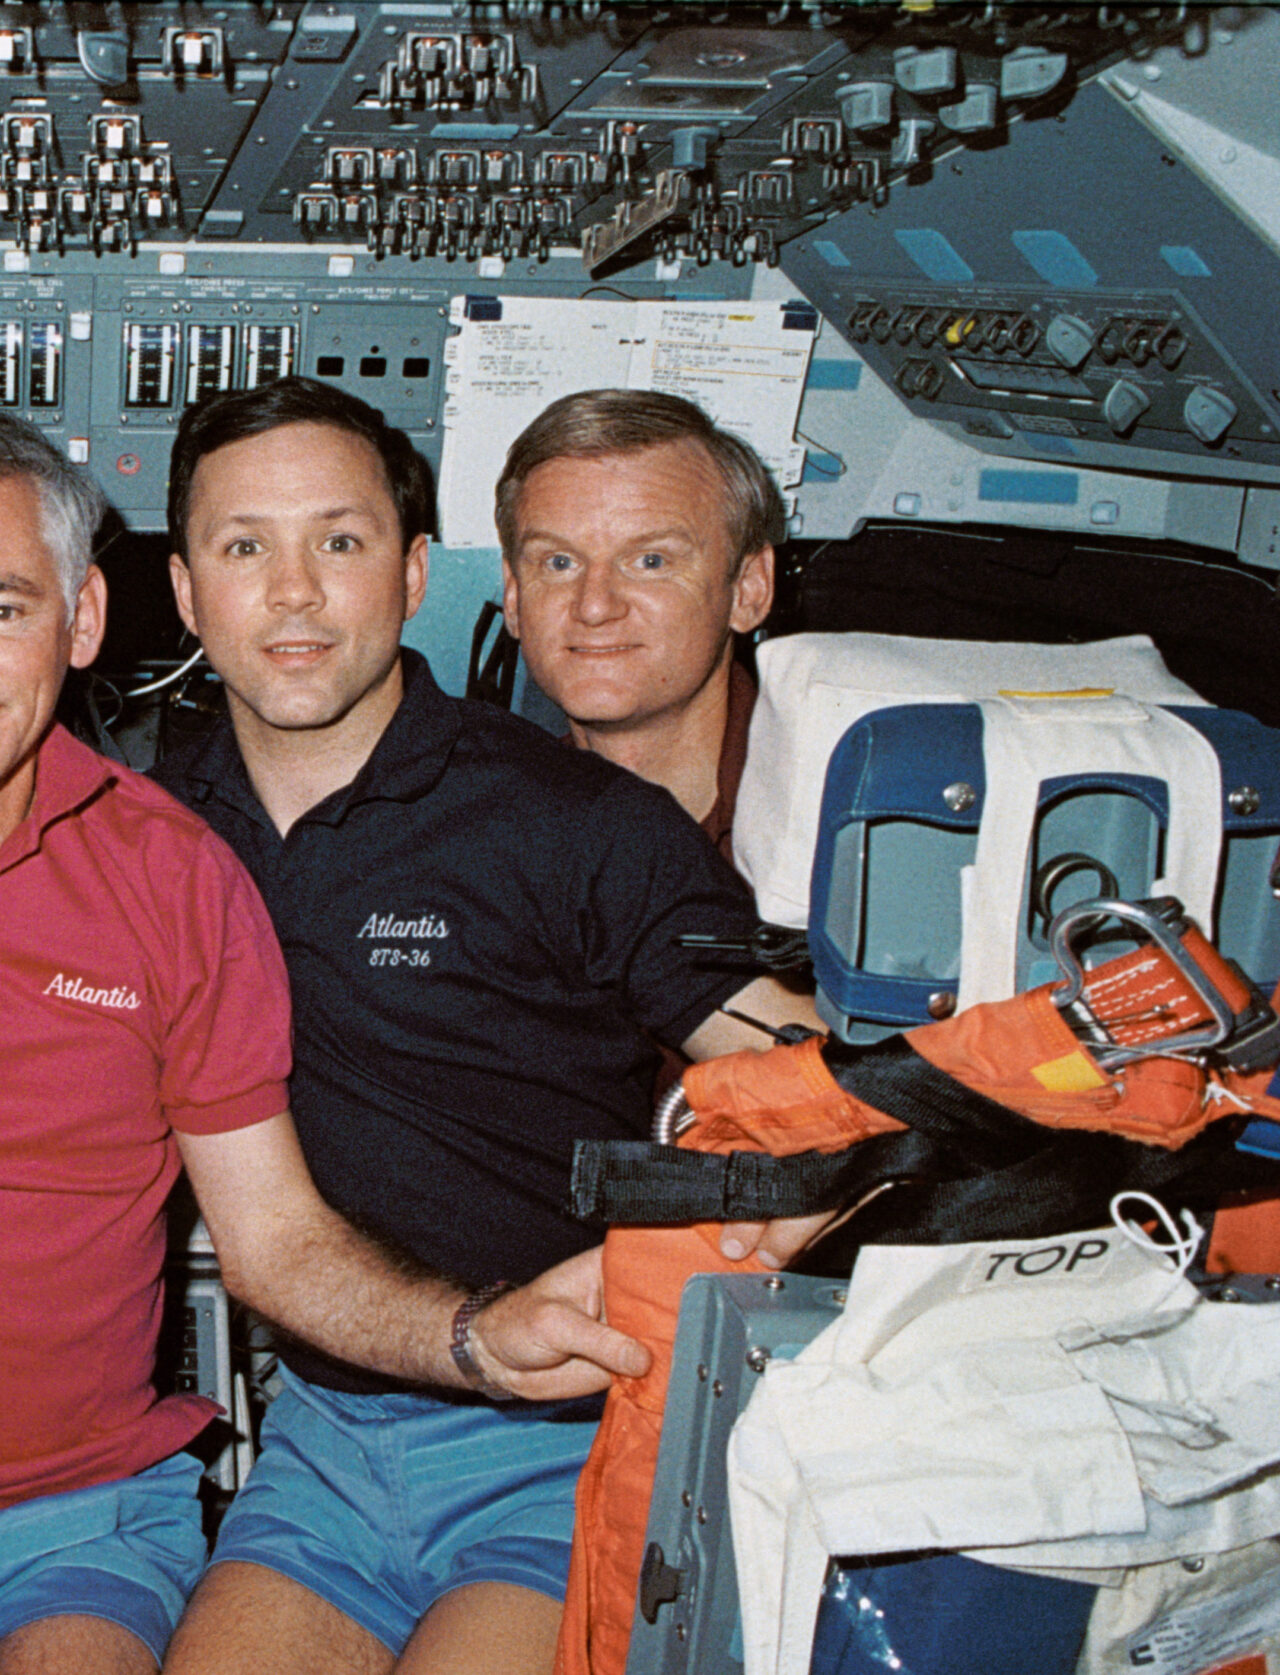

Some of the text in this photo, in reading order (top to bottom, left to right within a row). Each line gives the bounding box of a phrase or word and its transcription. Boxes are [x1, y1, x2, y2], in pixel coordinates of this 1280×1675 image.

[357, 912, 450, 939] Atlantis
[368, 948, 431, 967] STS-36
[42, 972, 141, 1010] Atlantis
[985, 1239, 1110, 1281] TOP
